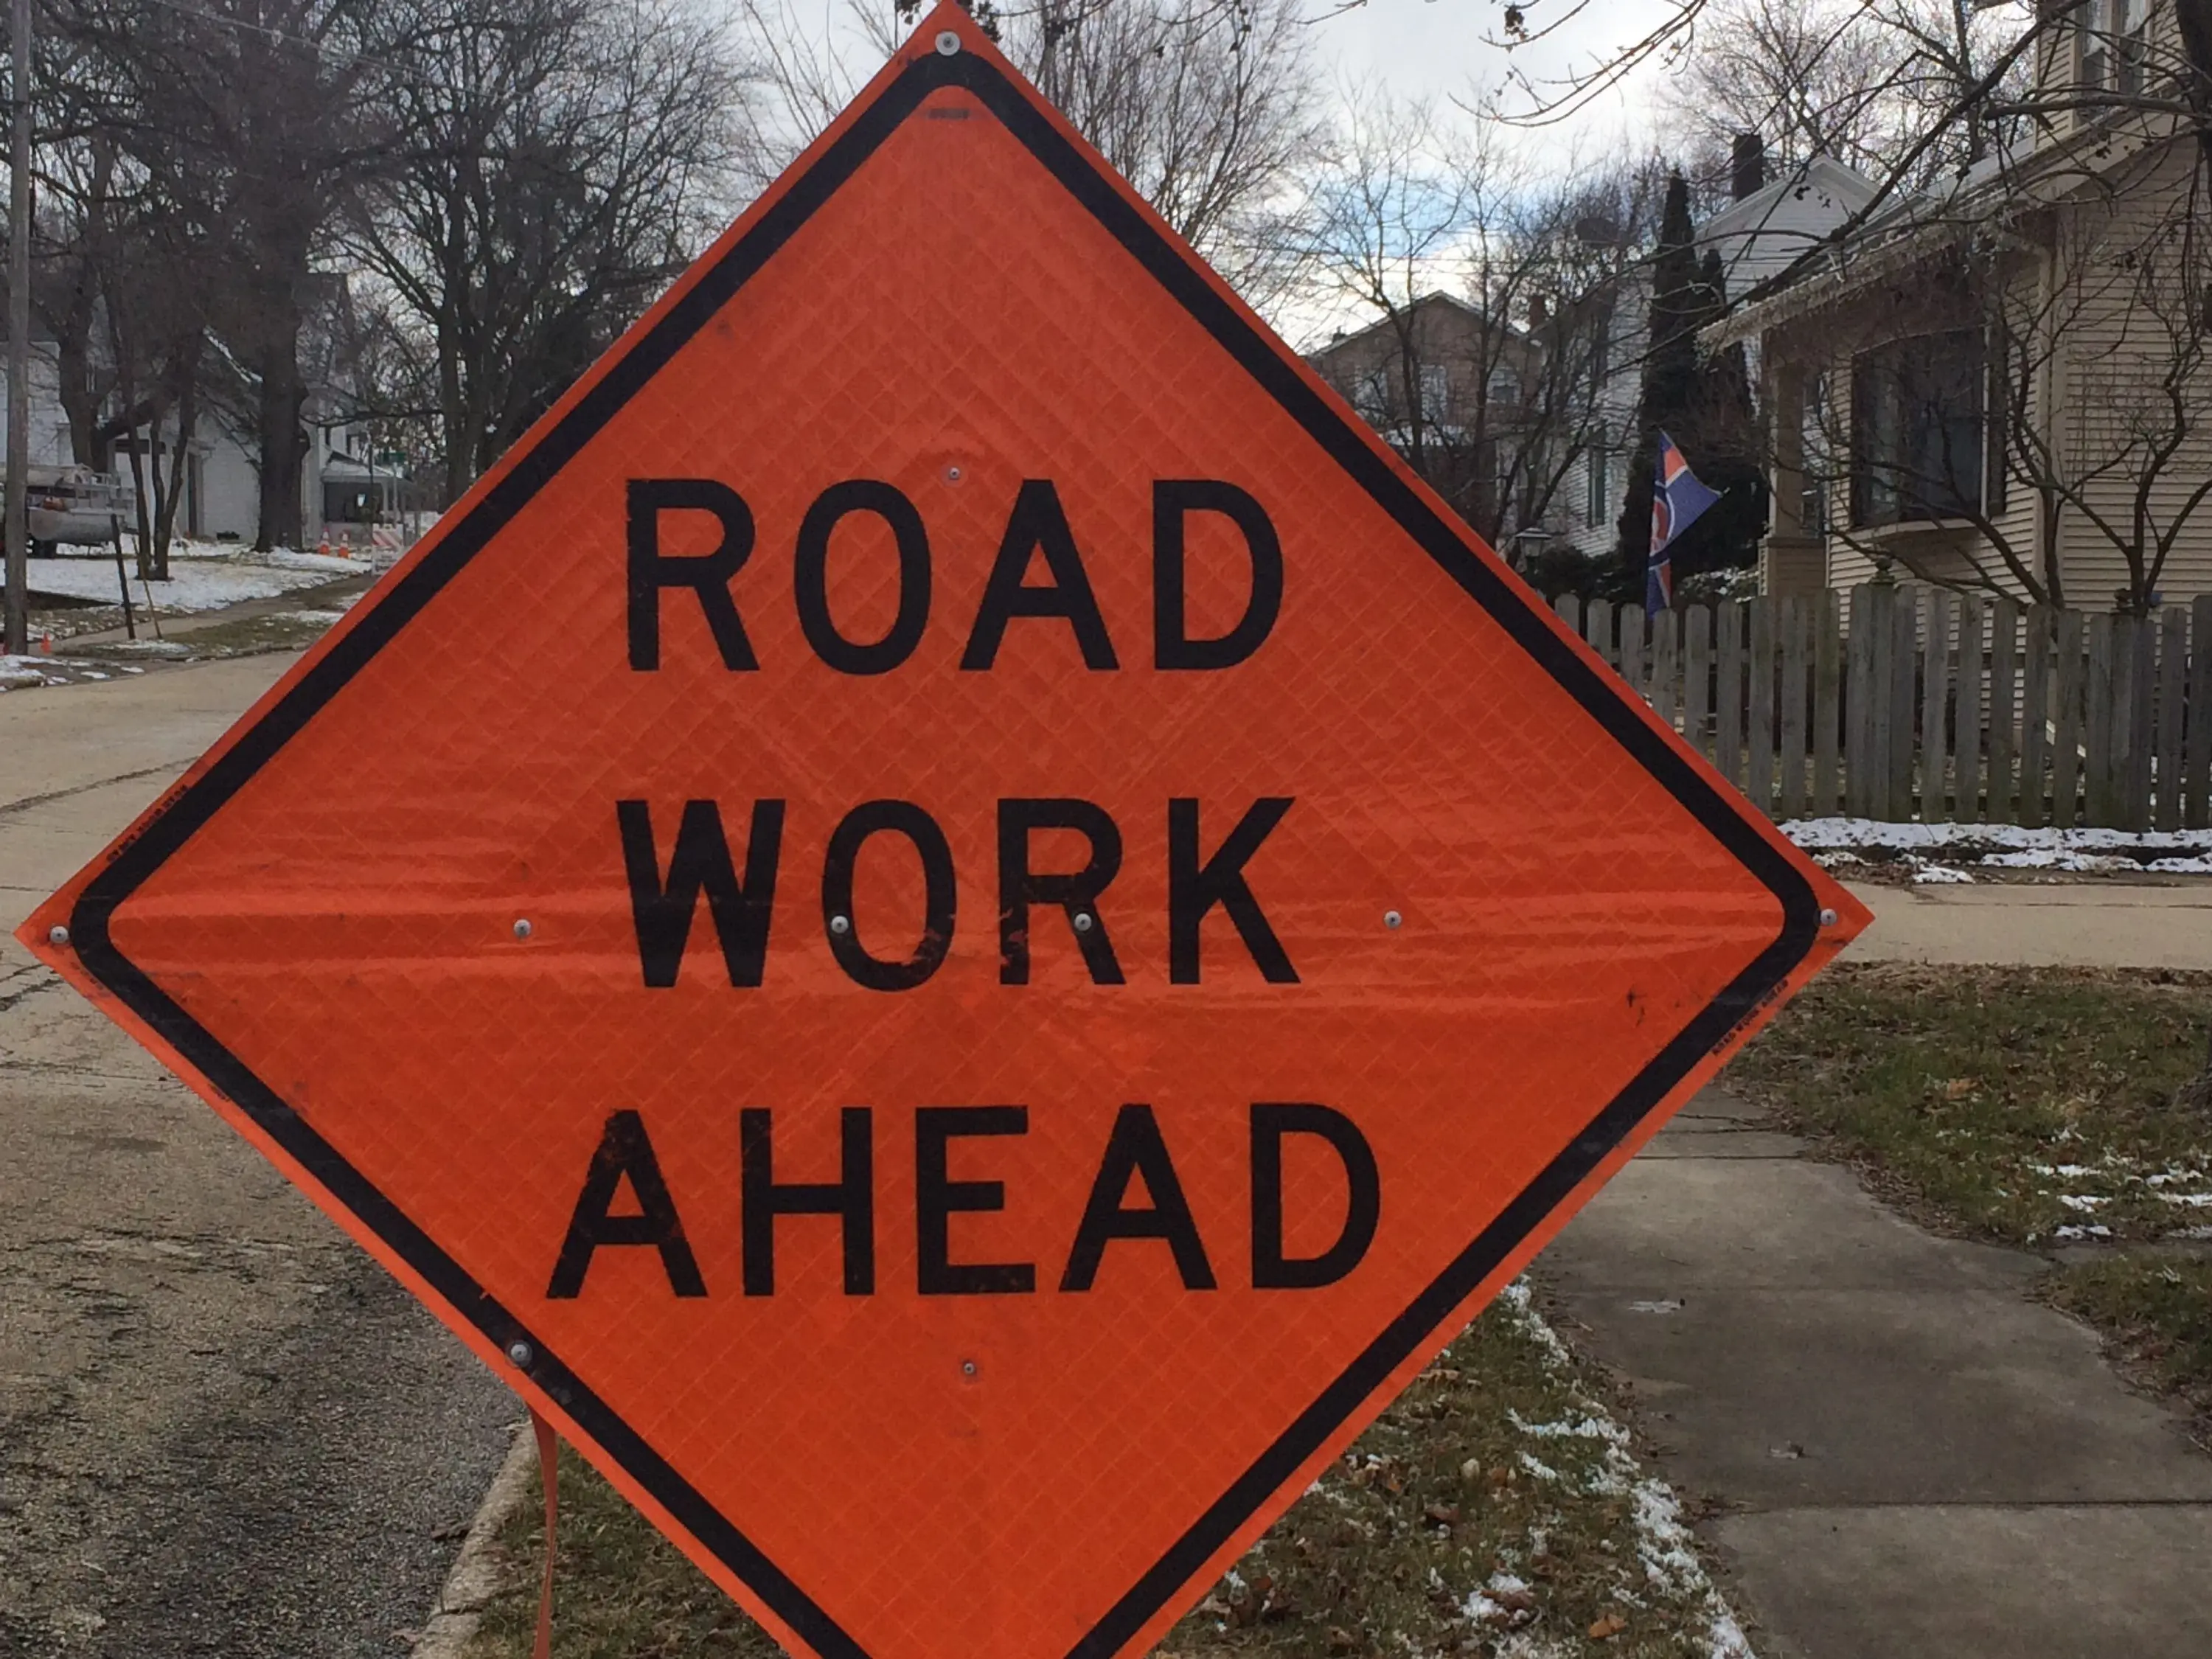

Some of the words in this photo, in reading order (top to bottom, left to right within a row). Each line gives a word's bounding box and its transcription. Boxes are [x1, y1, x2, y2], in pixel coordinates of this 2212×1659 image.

[627, 479, 1283, 675] ROAD
[617, 798, 1299, 991] WORK
[547, 1104, 1380, 1298] AHEAD
